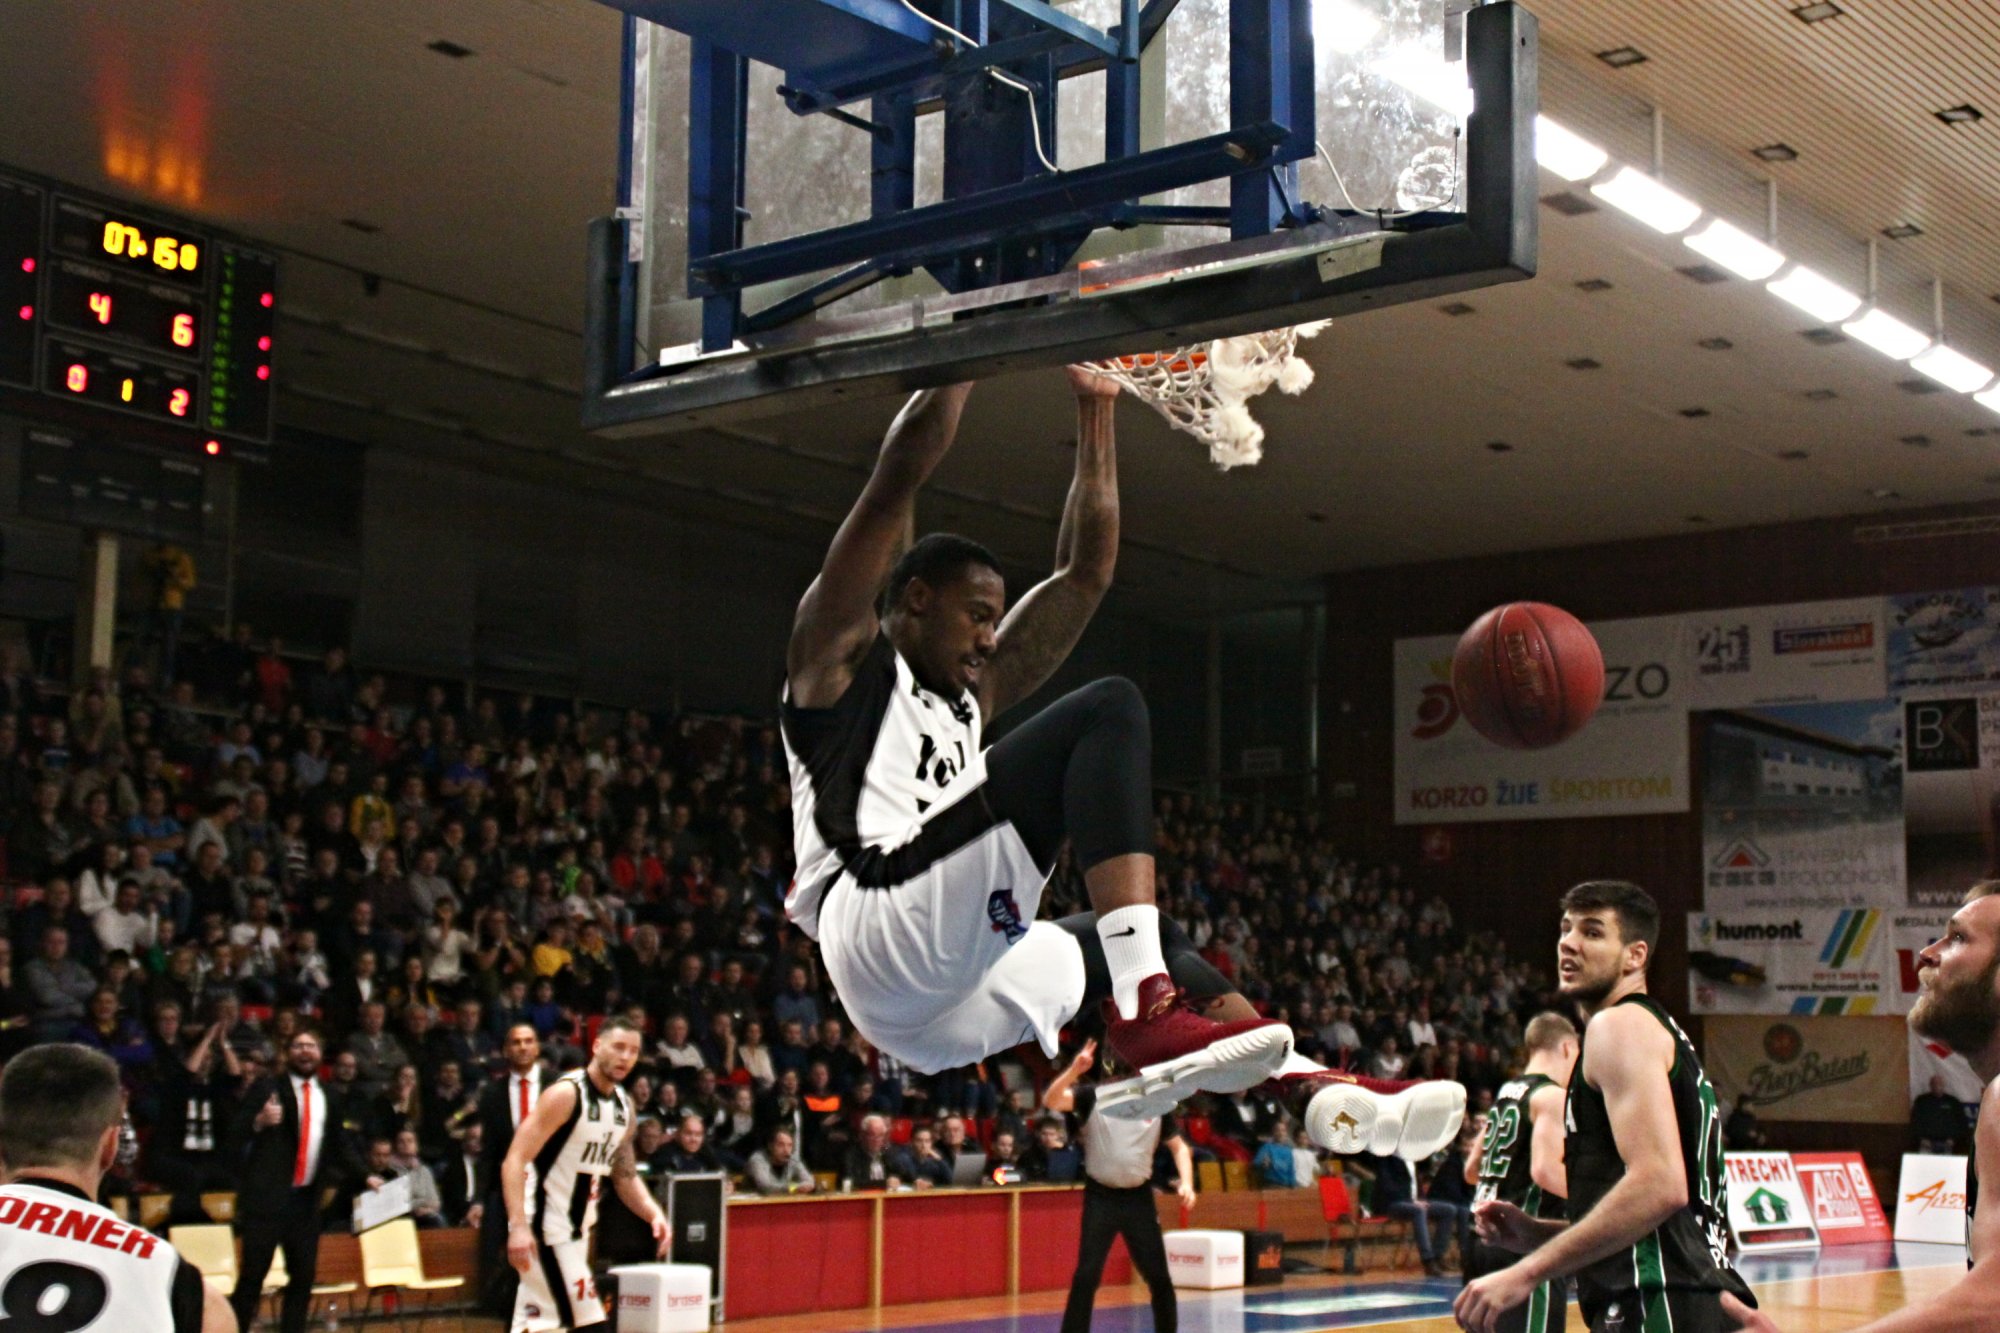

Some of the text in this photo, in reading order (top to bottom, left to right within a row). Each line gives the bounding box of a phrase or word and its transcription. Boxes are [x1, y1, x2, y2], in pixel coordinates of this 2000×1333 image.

[90, 293, 111, 324] 4
[172, 314, 194, 346] 6
[1411, 786, 1488, 809] KORZO
[1716, 920, 1803, 940] humont
